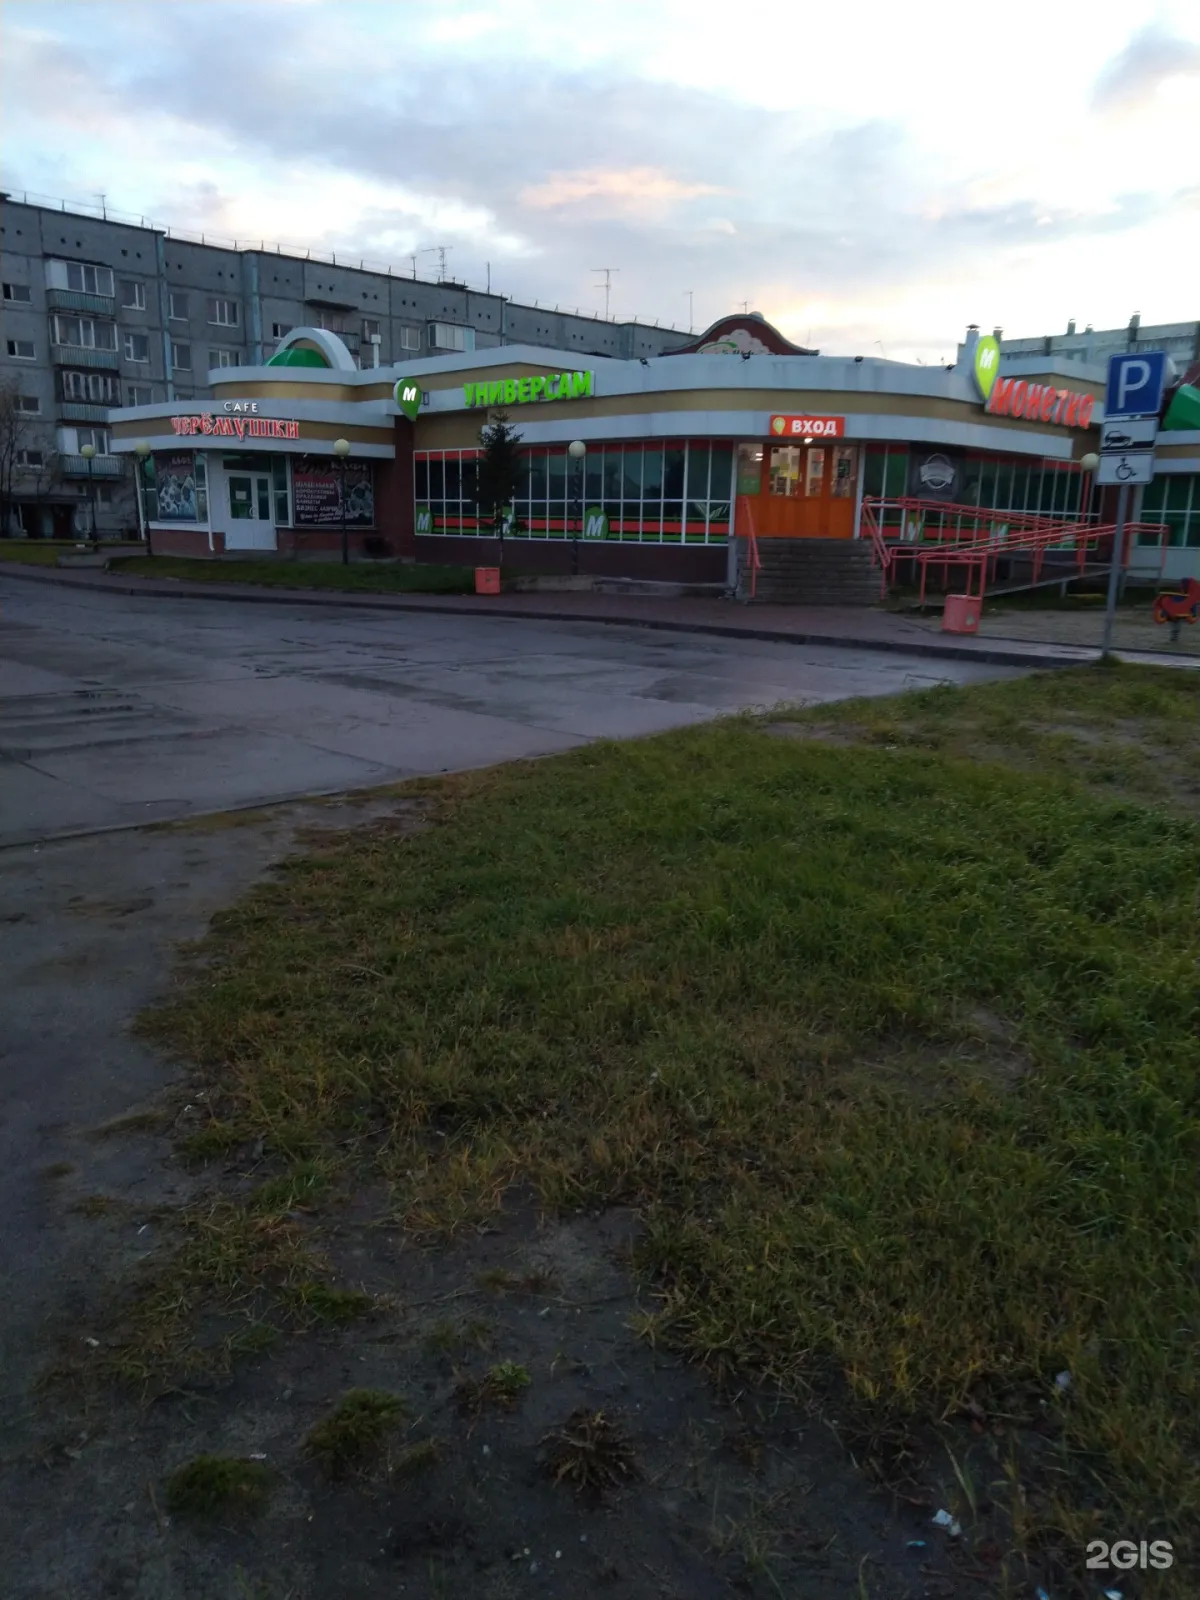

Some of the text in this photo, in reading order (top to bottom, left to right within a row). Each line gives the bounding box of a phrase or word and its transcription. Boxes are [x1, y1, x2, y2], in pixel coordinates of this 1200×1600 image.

[463, 370, 592, 408] УНИВЕРСАМ
[1117, 359, 1152, 409] P
[223, 401, 258, 413] CAFE
[170, 412, 300, 441] ЧЕРЁМУШКИ
[791, 419, 837, 436] ВХОД
